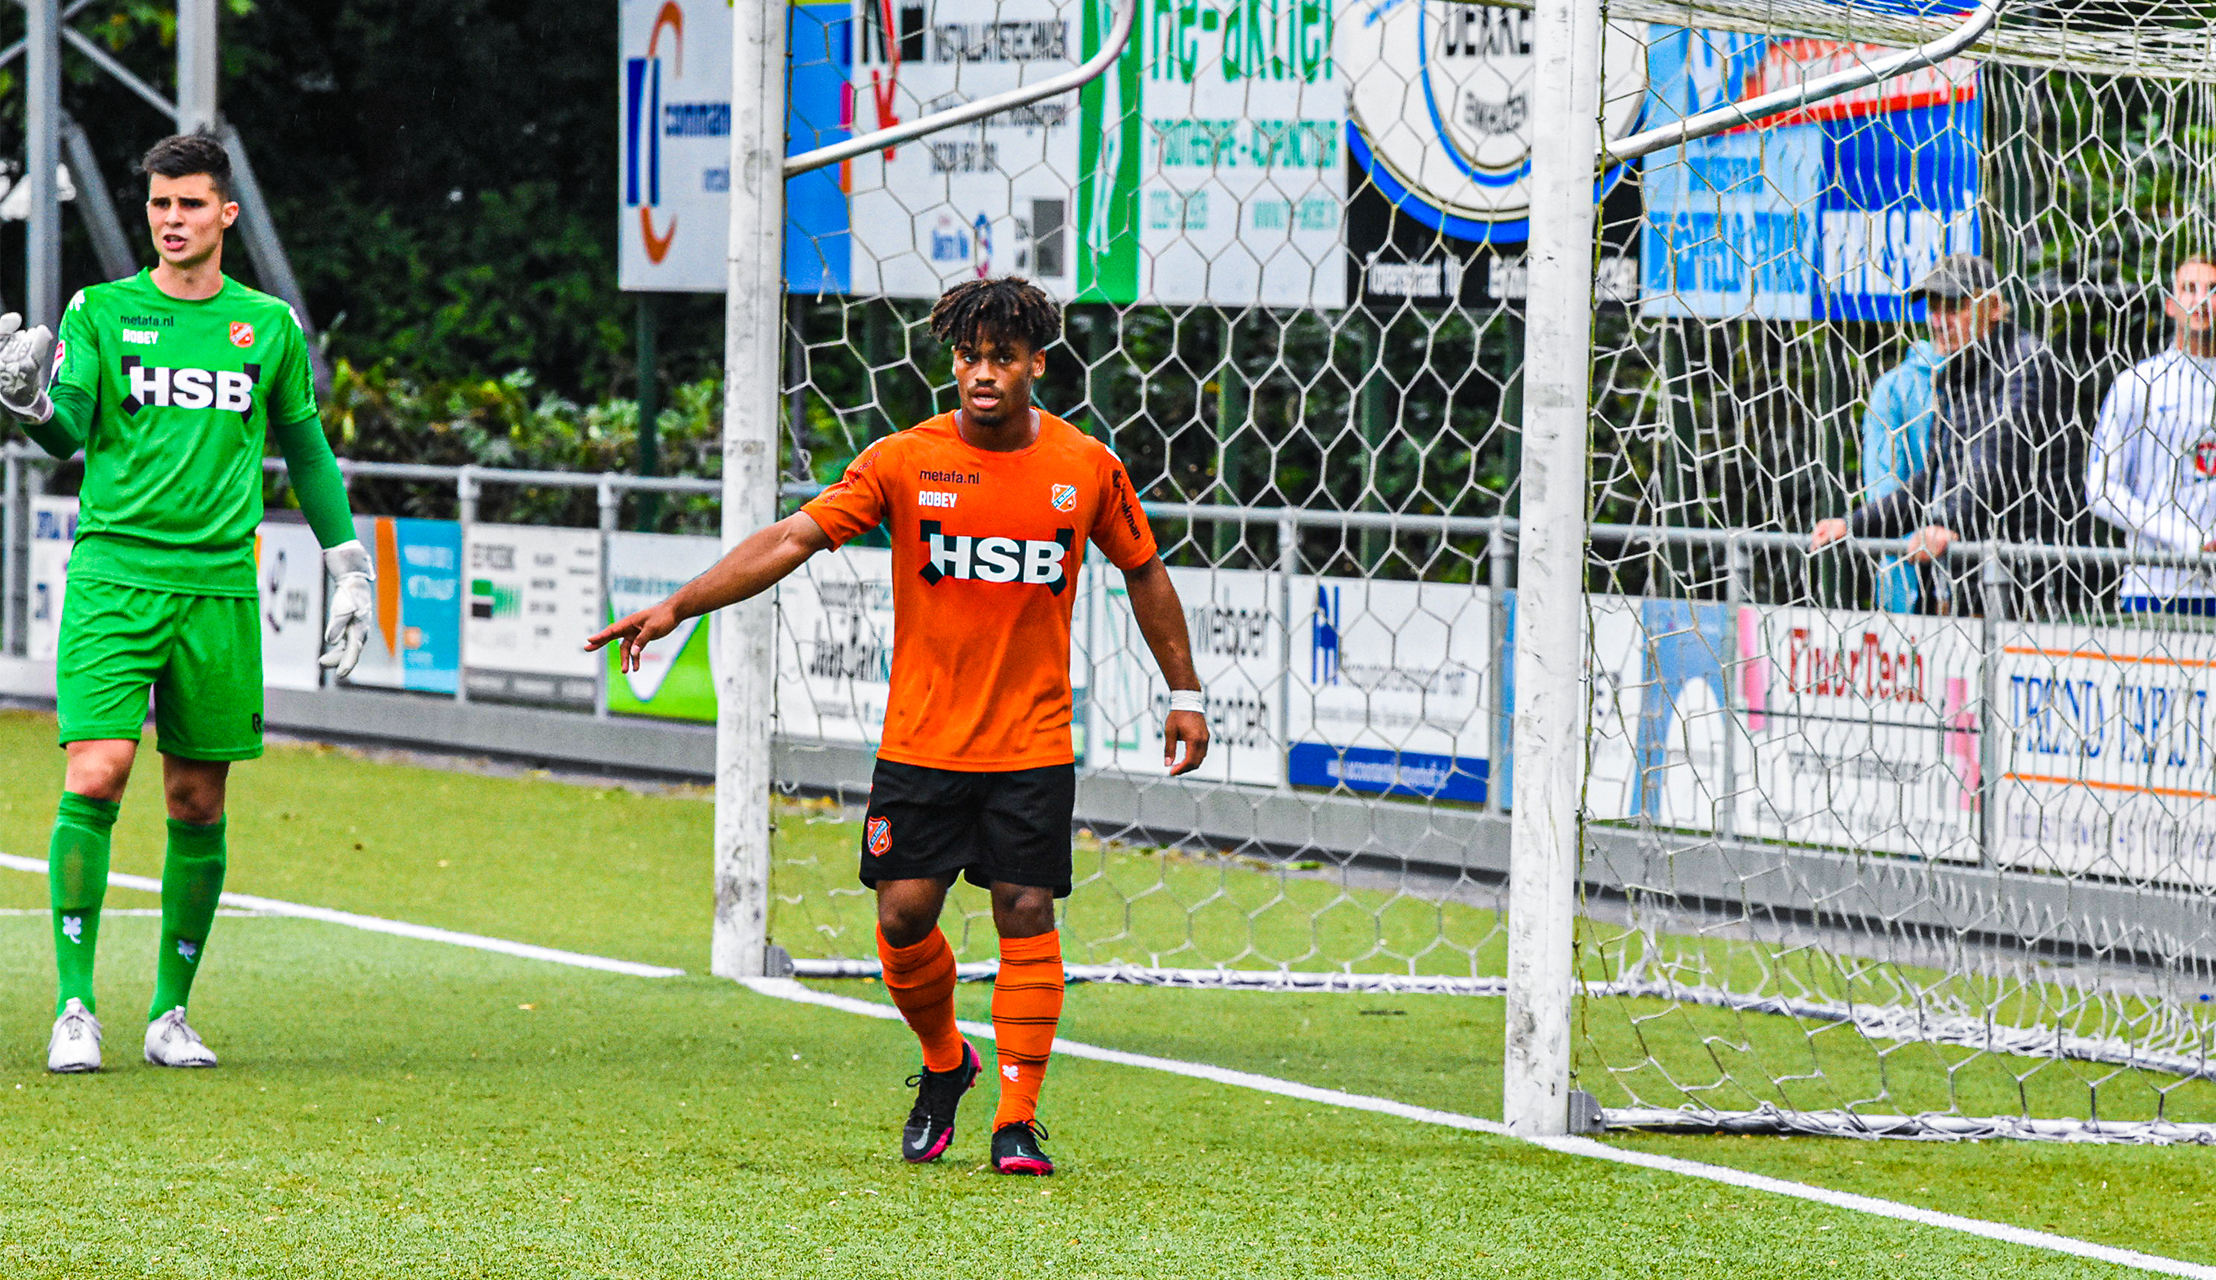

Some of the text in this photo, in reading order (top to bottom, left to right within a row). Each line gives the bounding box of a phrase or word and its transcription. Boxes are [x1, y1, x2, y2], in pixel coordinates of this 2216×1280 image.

[120, 315, 174, 327] metafa.nl
[122, 329, 159, 344] ROBEY
[129, 366, 253, 413] HSB
[919, 470, 981, 485] metafa.nl
[918, 491, 958, 508] ROBEY
[929, 532, 1066, 584] HSB
